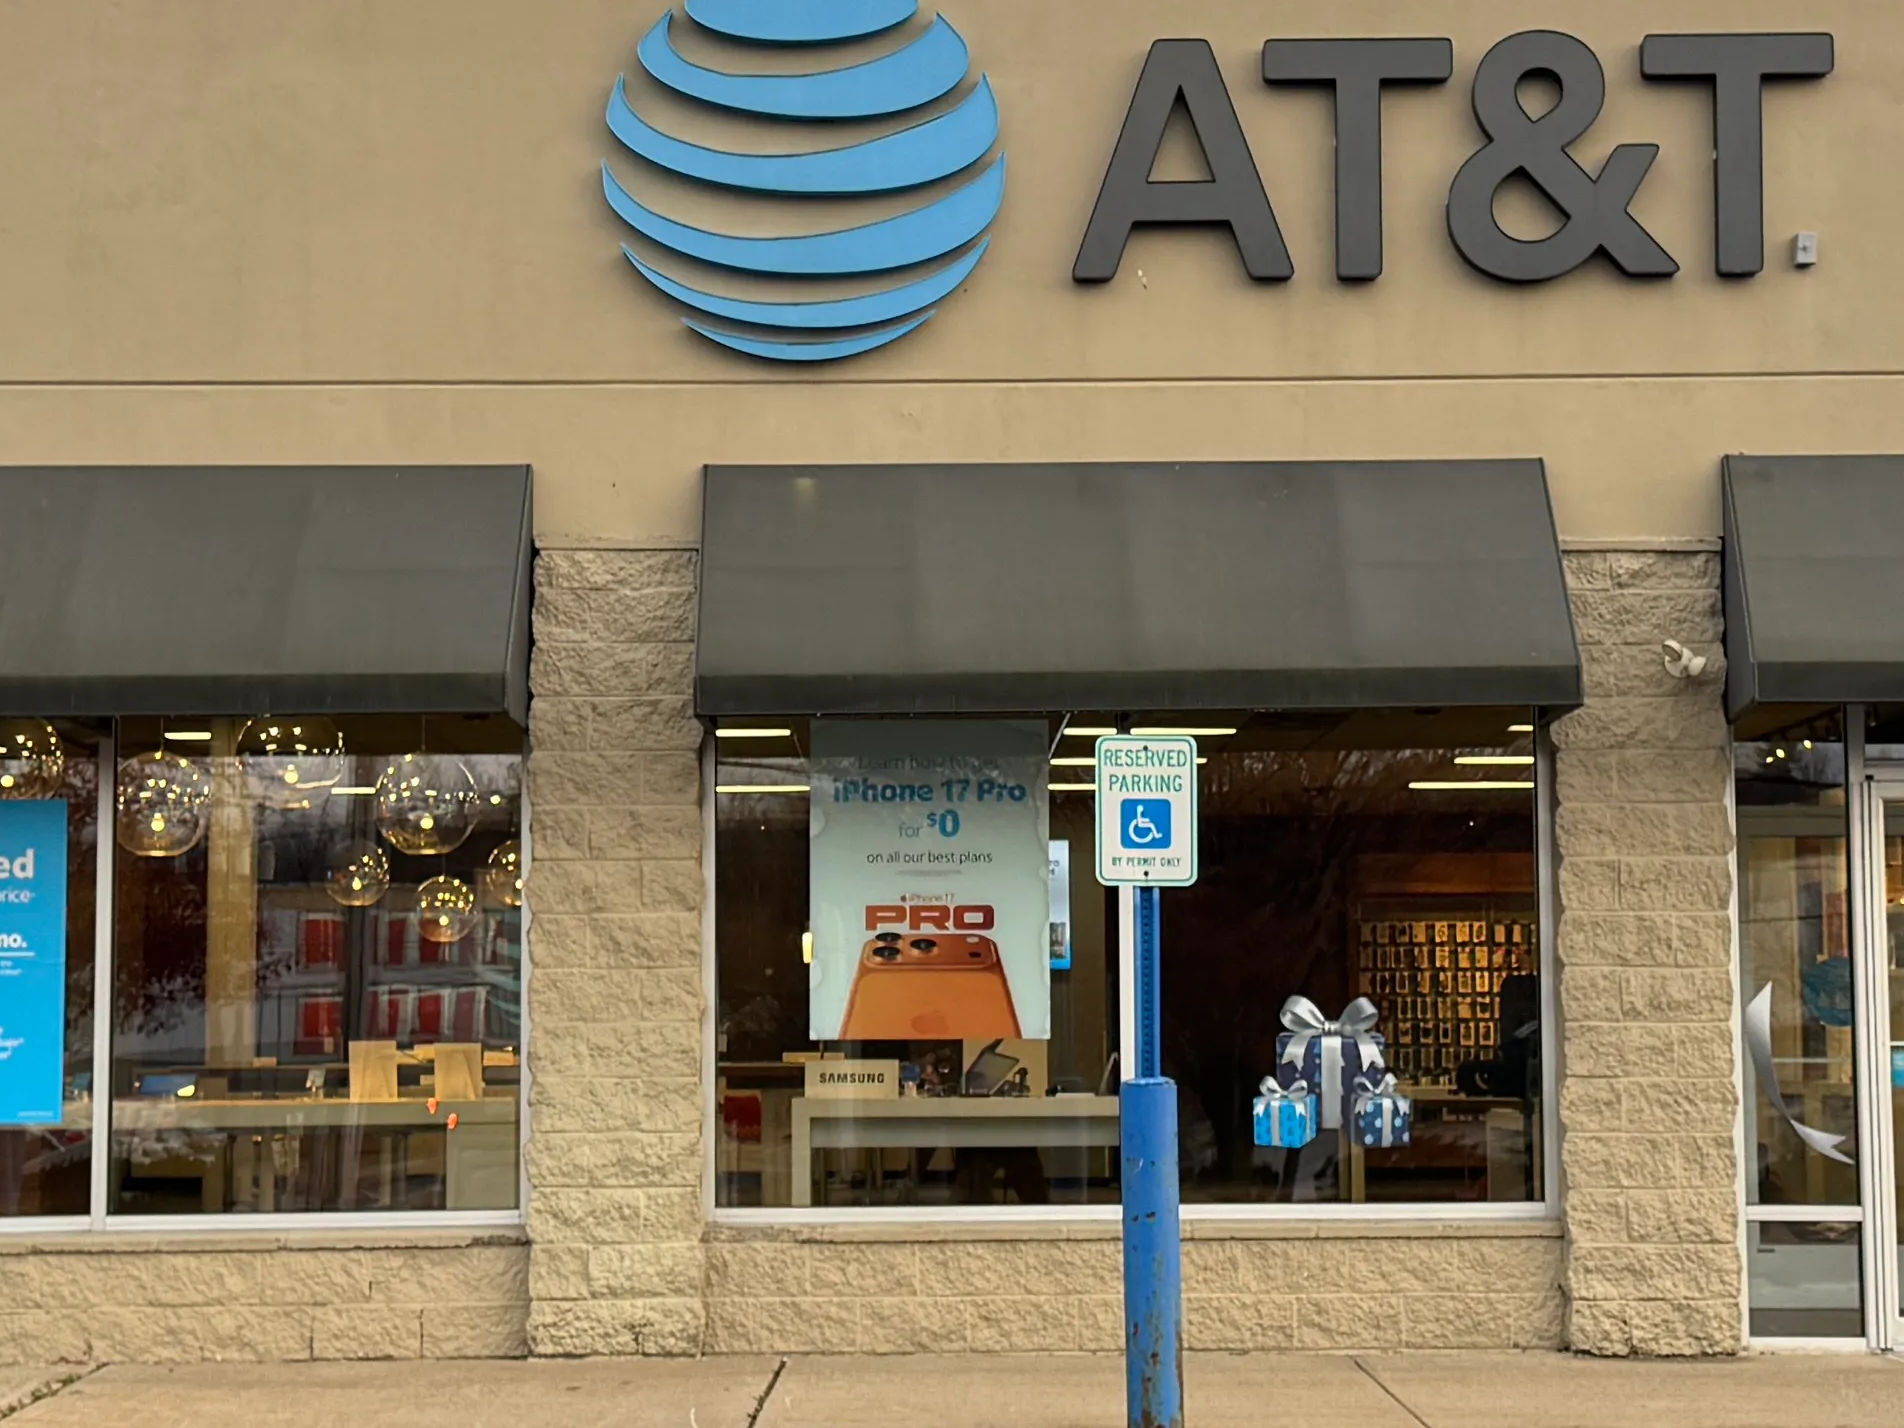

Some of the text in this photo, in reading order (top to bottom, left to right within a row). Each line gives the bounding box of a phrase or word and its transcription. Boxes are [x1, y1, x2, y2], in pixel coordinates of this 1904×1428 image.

[1072, 29, 1835, 283] AT&T
[858, 754, 904, 770] Learn
[1103, 748, 1187, 768] RESERVED
[833, 776, 1026, 803] iPhone 17 Pro
[1109, 774, 1183, 792] PARKING
[898, 809, 961, 838] for $0
[866, 850, 993, 866] on all our best plans
[1112, 856, 1182, 867] BY PERMIT ONLY
[908, 893, 943, 903] iPhone
[865, 905, 995, 931] PRO
[819, 1072, 885, 1084] SAMSUNG
